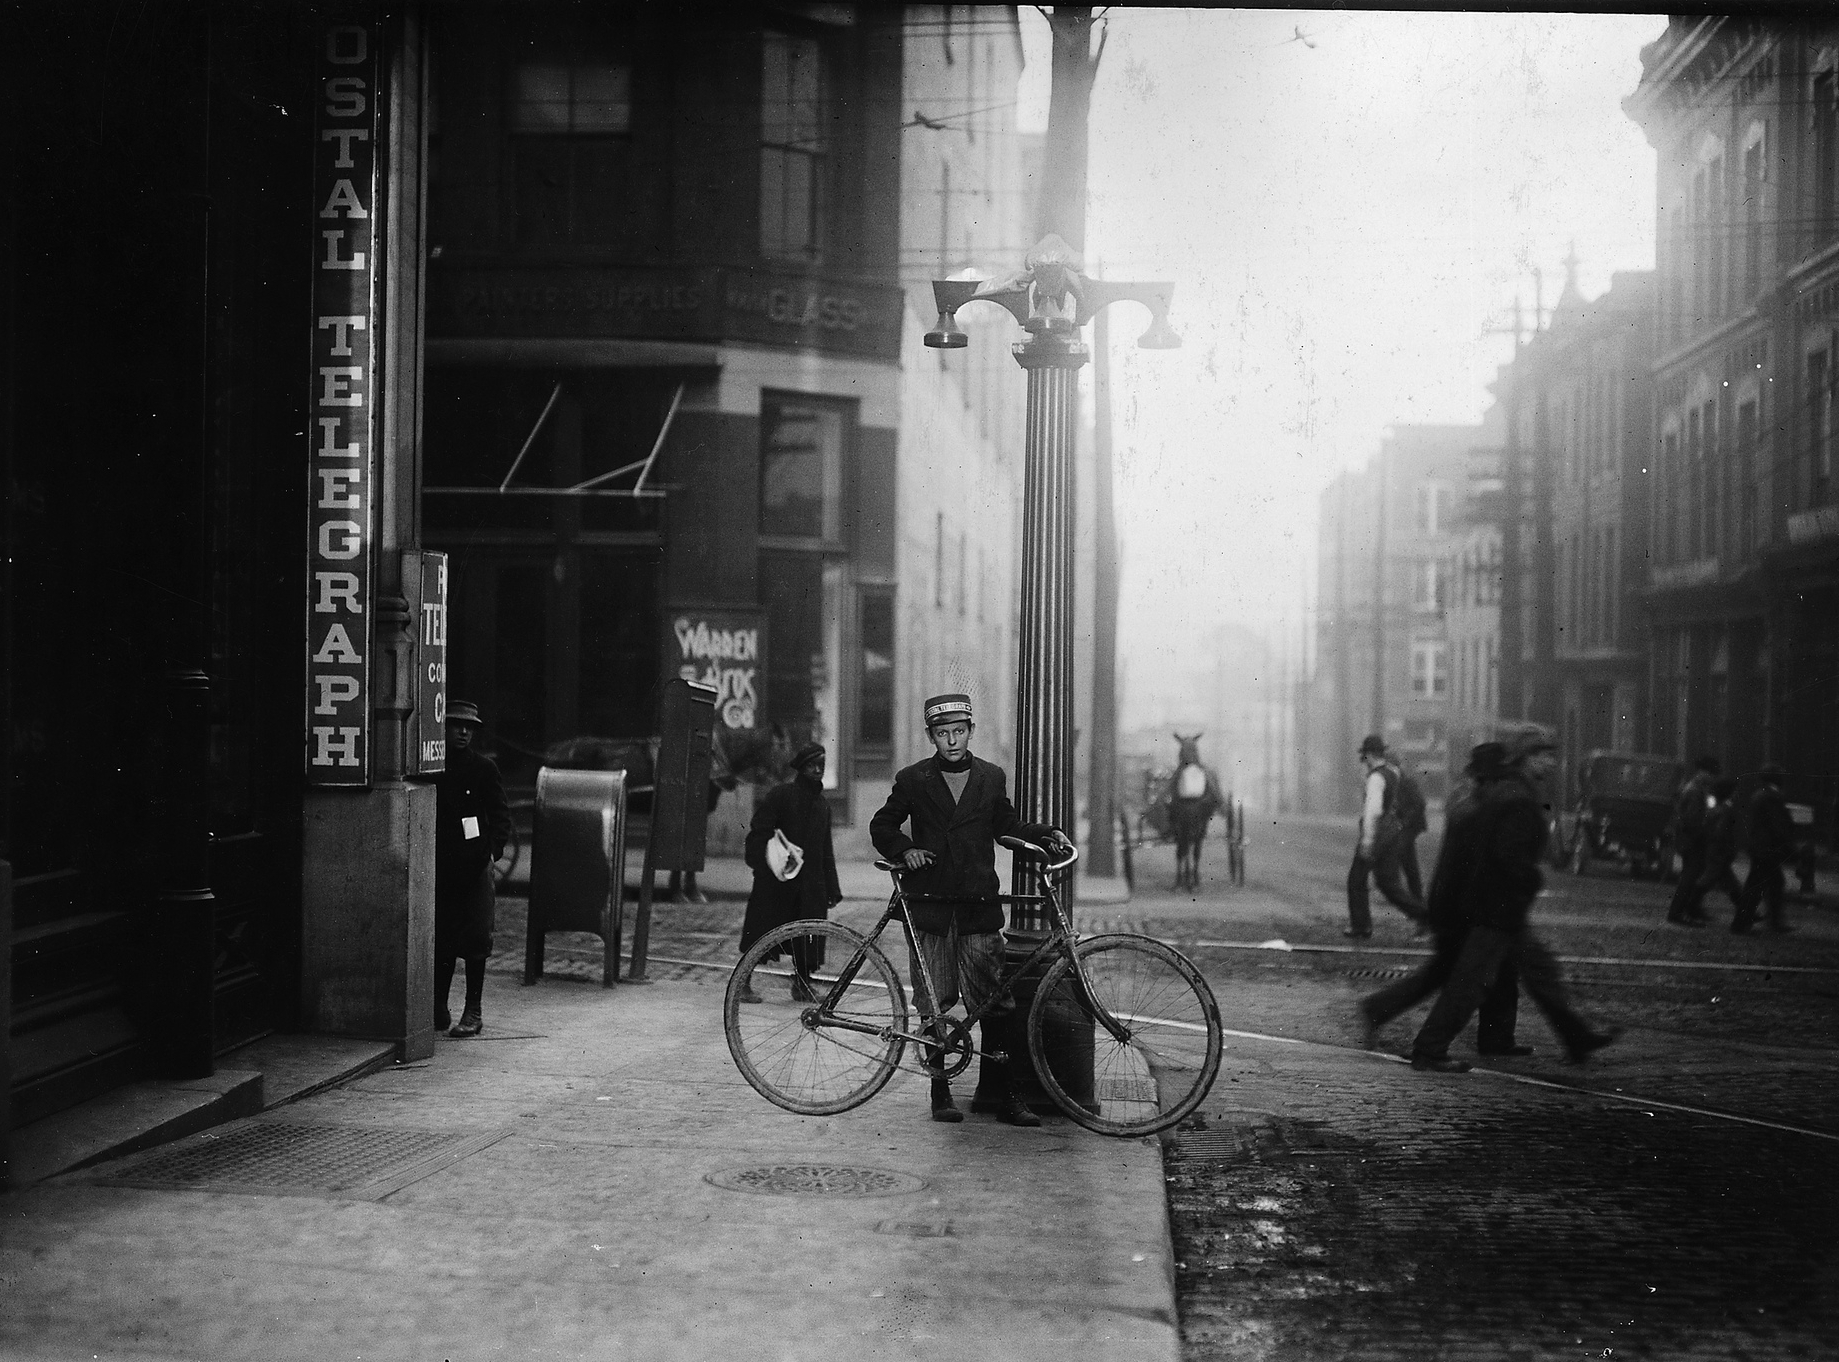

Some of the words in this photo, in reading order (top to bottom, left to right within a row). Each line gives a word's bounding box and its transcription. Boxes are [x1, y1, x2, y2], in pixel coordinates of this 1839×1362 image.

[320, 25, 369, 270] OSTAL
[767, 288, 861, 332] GLASS
[312, 315, 366, 766] TELEGRAPH
